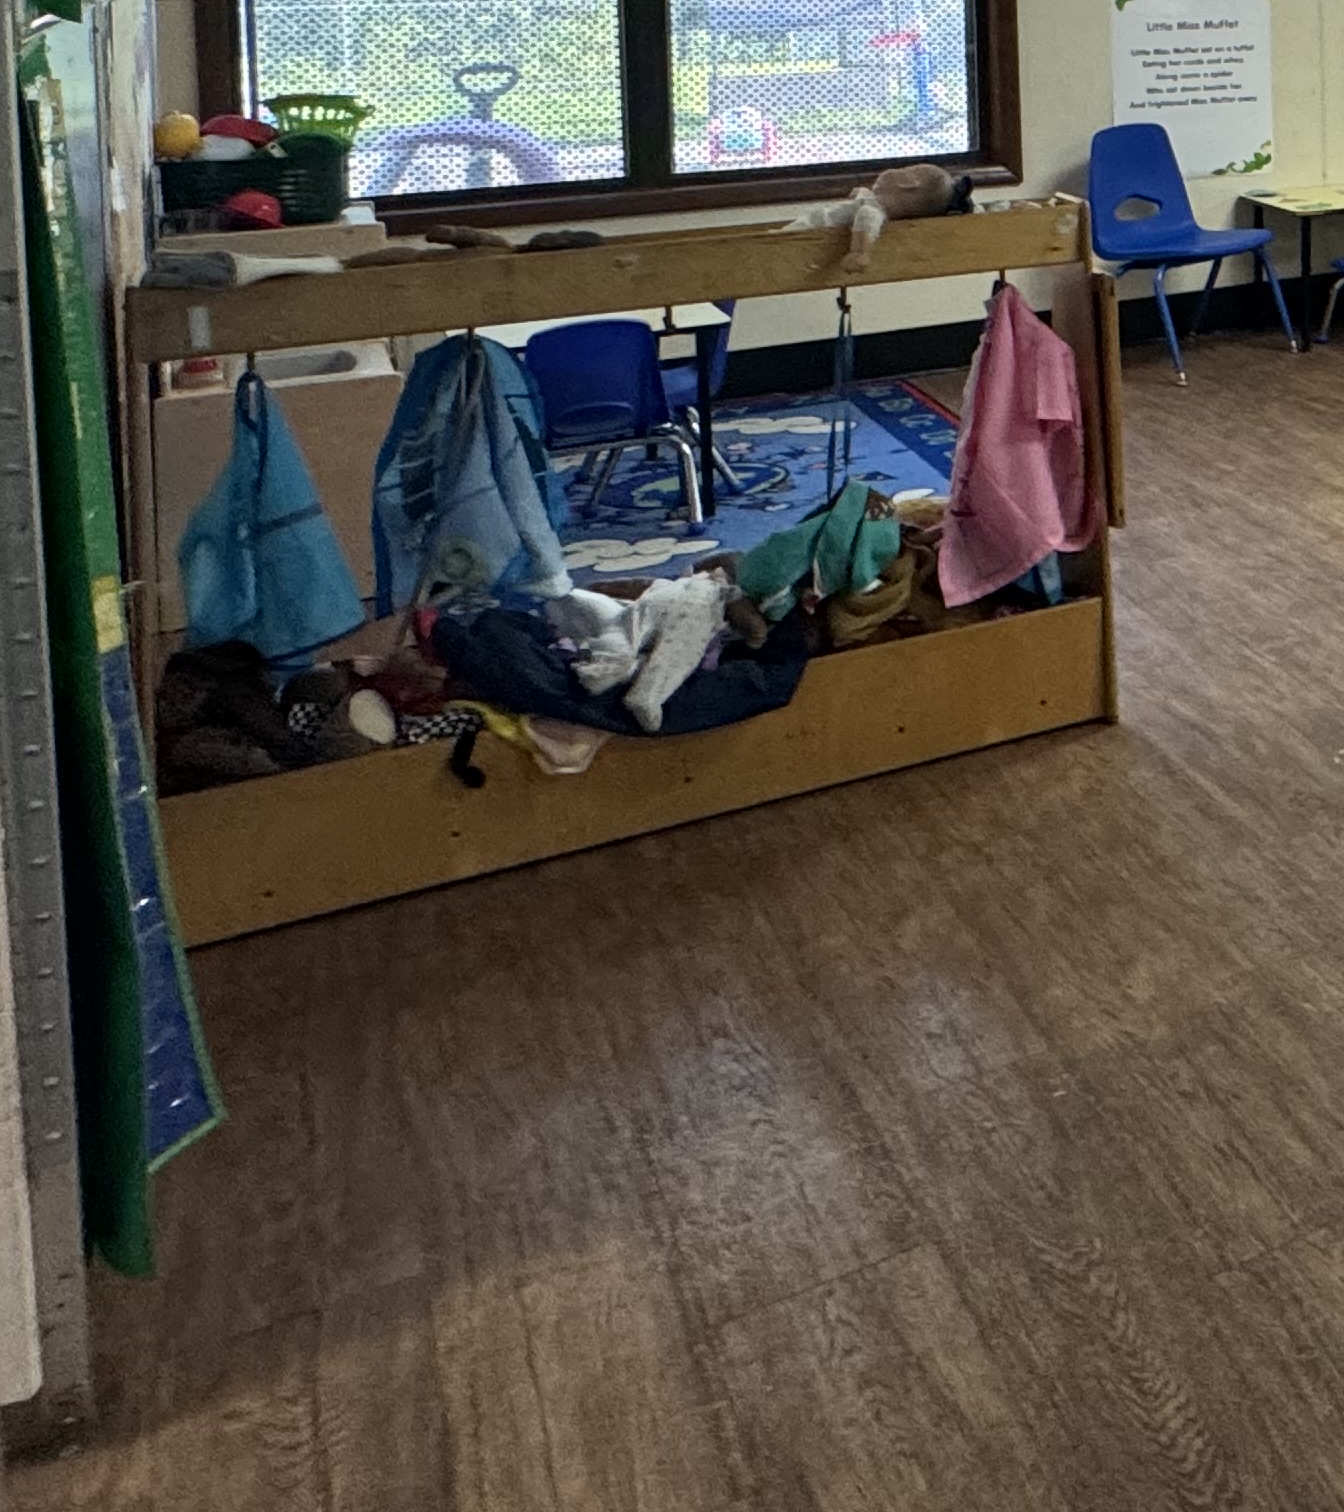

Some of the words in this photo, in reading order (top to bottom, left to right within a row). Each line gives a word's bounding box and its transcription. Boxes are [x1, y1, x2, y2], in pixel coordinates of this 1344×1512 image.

[1146, 22, 1173, 32] Little
[1177, 21, 1200, 30] Miss
[1203, 20, 1239, 29] Muffet
